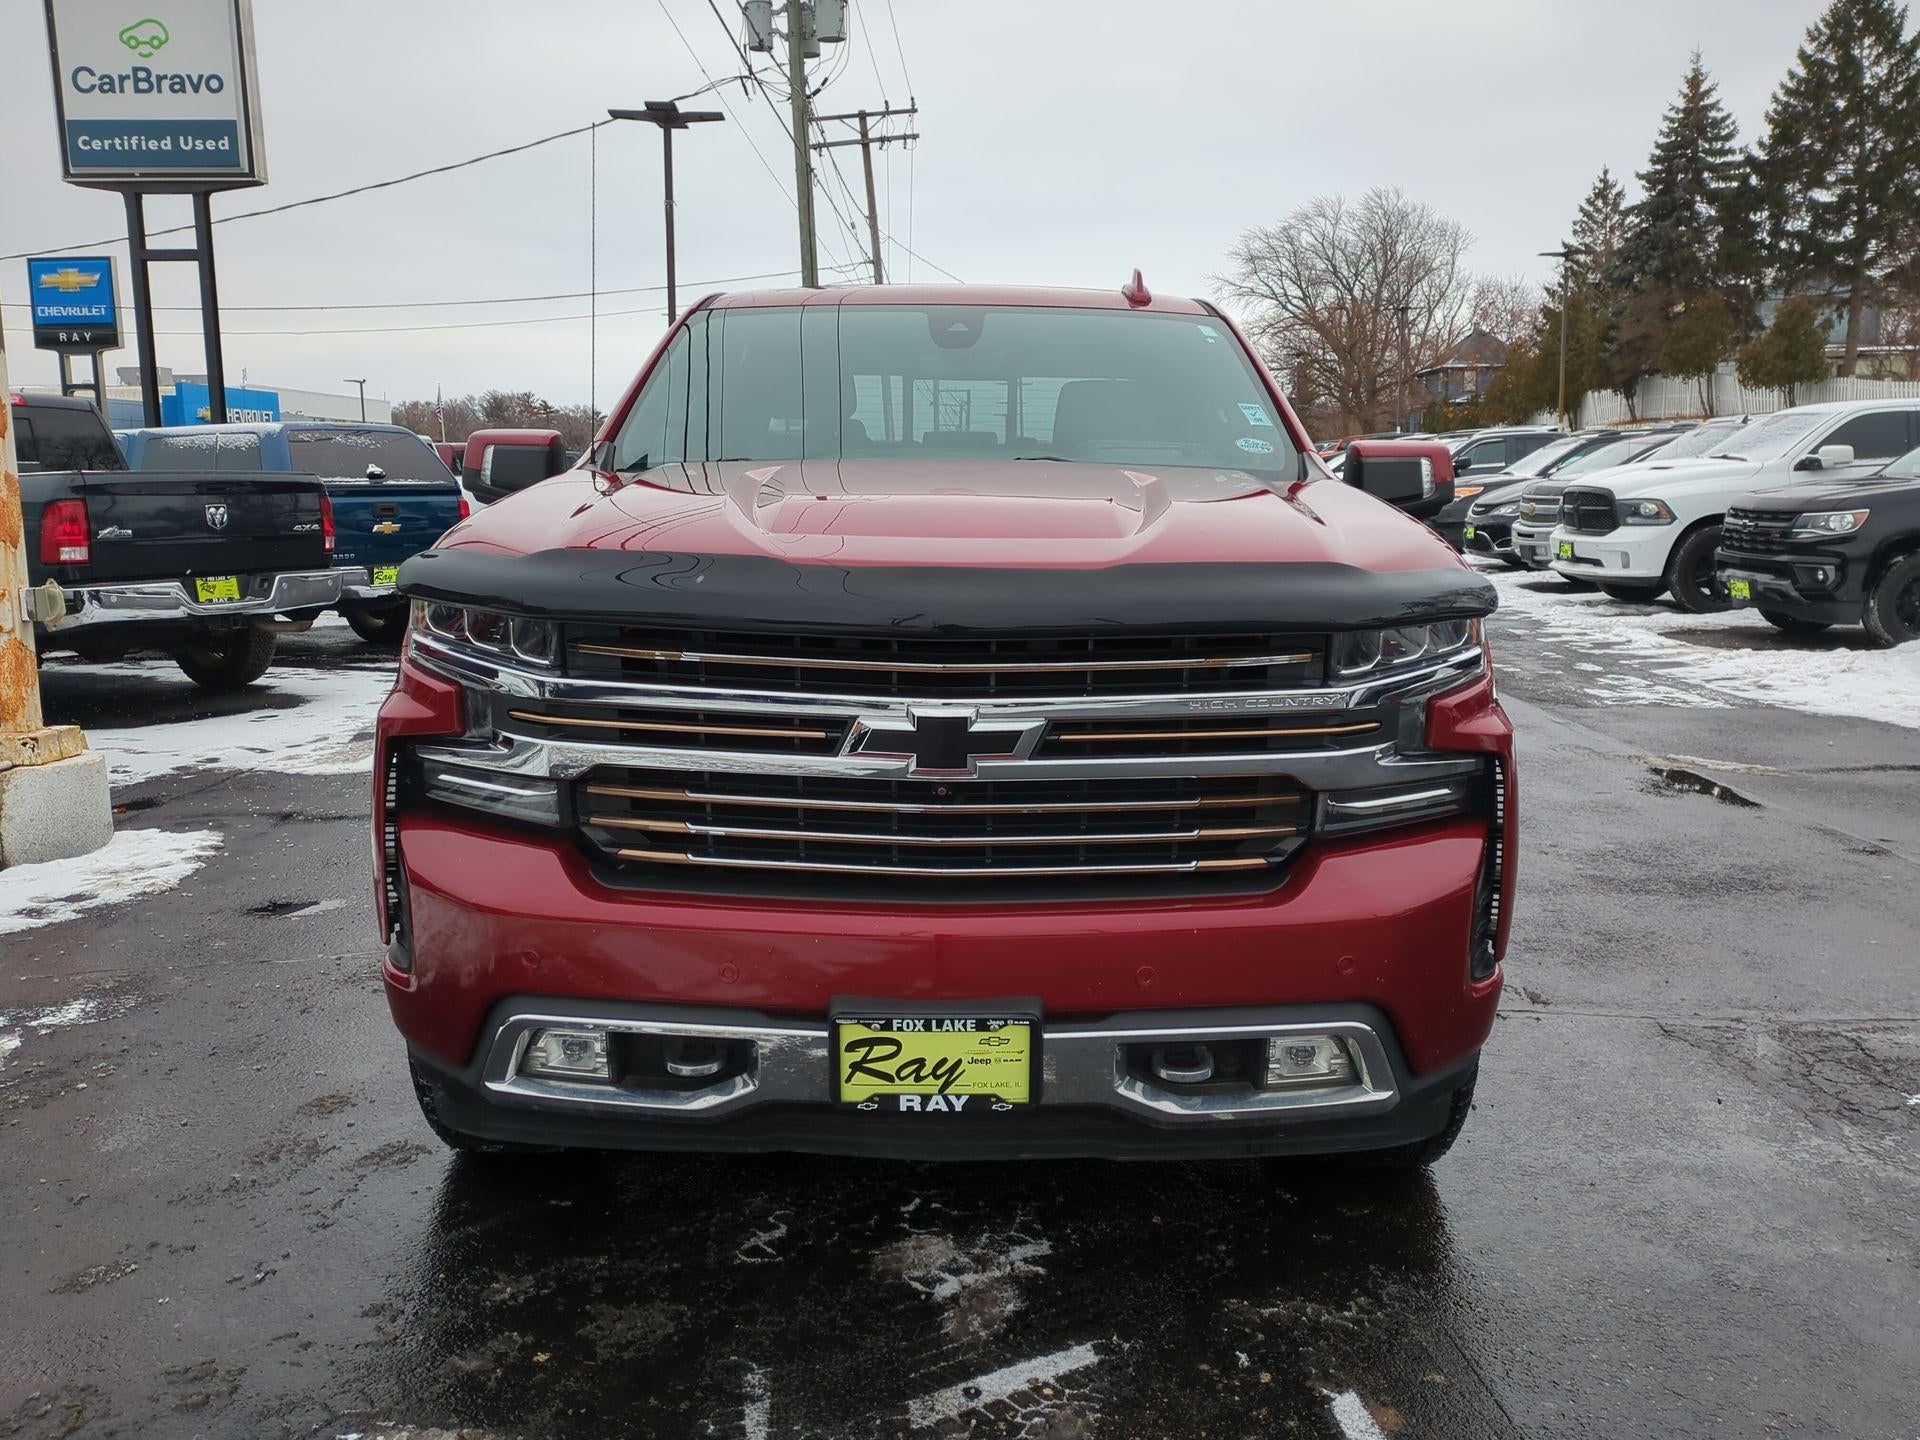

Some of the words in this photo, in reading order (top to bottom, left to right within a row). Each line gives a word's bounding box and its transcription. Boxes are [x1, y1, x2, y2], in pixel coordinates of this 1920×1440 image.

[71, 65, 224, 94] CarBravo
[77, 135, 171, 151] Certified
[179, 135, 229, 151] Used
[59, 331, 91, 342] RAY
[226, 408, 273, 423] HEVROLET
[1245, 696, 1338, 708] COUNTRY
[892, 1019, 925, 1032] FOX
[932, 1019, 976, 1032] LAKE
[844, 1036, 966, 1094] Ray
[967, 1056, 992, 1066] Jeep
[990, 1081, 1013, 1089] LAKE,
[899, 1094, 970, 1112] RAY
